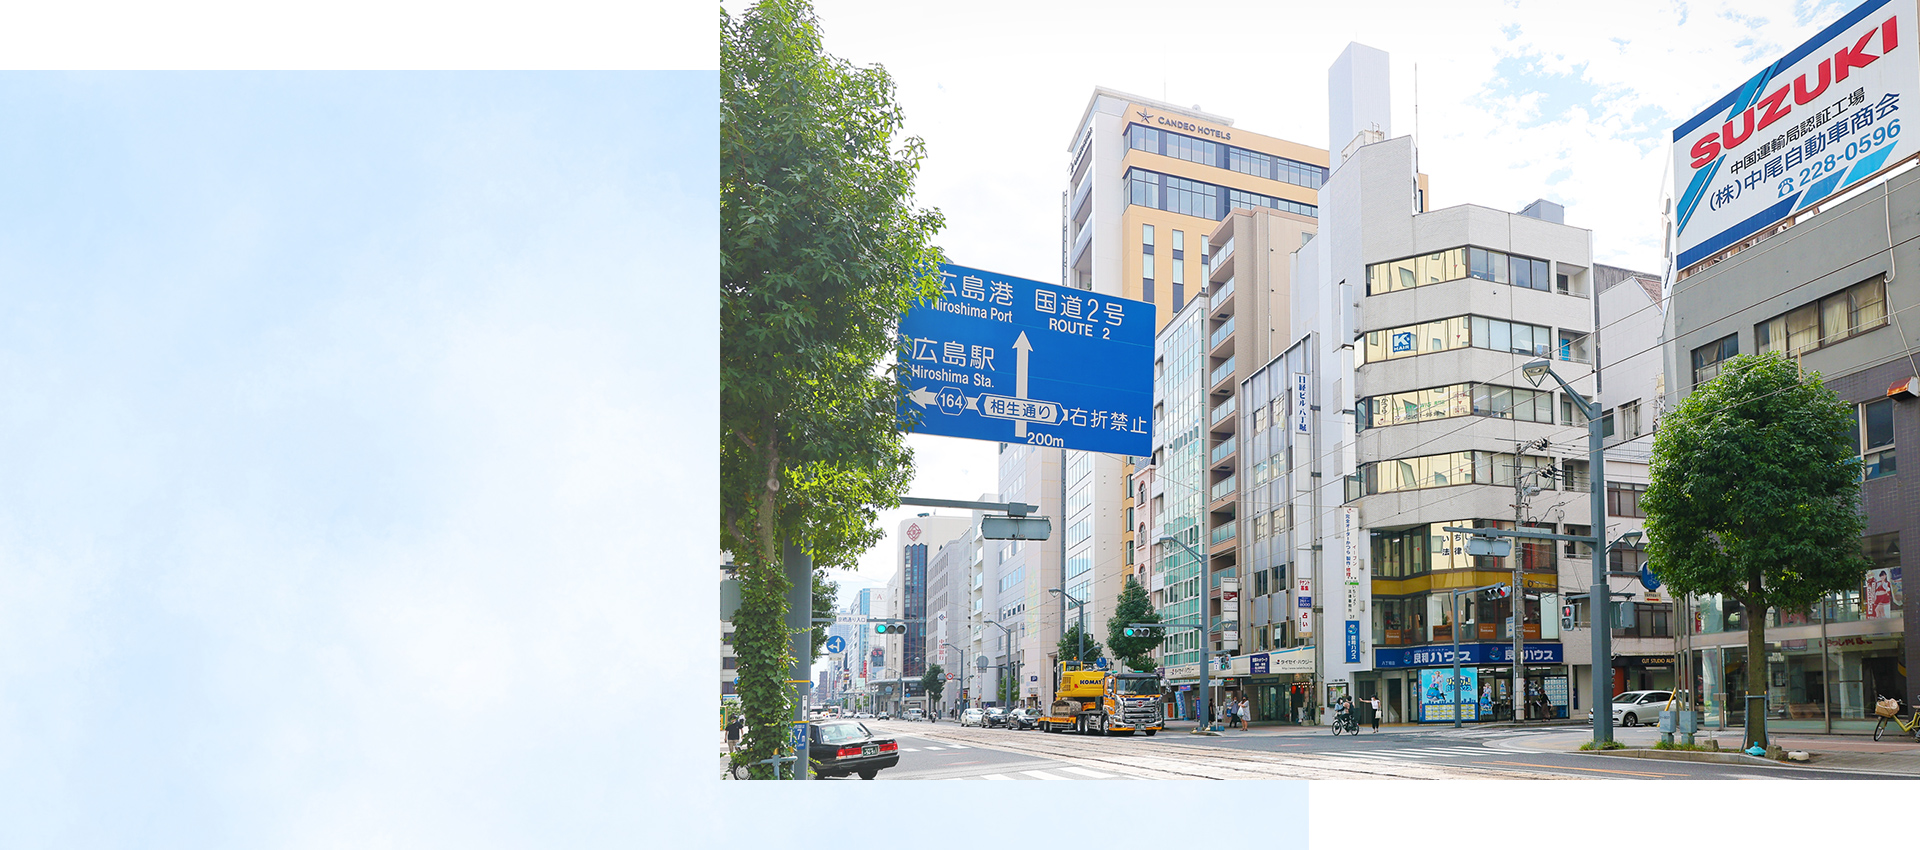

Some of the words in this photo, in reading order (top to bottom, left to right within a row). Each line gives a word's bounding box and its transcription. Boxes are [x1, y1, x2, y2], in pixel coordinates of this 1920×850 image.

[1690, 15, 1898, 169] SUZUKI
[1157, 115, 1196, 132] CANDEO
[1197, 125, 1232, 141] HOTELS
[1730, 86, 1866, 175] 中国運輸局認証工場
[1709, 92, 1900, 212] (株)中尾自動車商会
[1799, 118, 1901, 188] 228-0596
[931, 298, 987, 319] Hiroshima
[990, 306, 1013, 323] Port
[941, 270, 1014, 307] 広島港
[1034, 288, 1126, 327] 国道2号
[1049, 318, 1093, 337] ROUTE
[1102, 327, 1110, 340] 2
[911, 337, 996, 371] 広島駅
[911, 364, 969, 385] Hiroshima
[973, 373, 994, 388] Sta.
[940, 393, 963, 409] 164
[990, 399, 1051, 419] 相生通り
[1069, 407, 1148, 435] 右折禁止
[1027, 432, 1064, 448] 200m
[1413, 651, 1471, 664] 良和ハウス
[1504, 649, 1553, 660] 良ハウス
